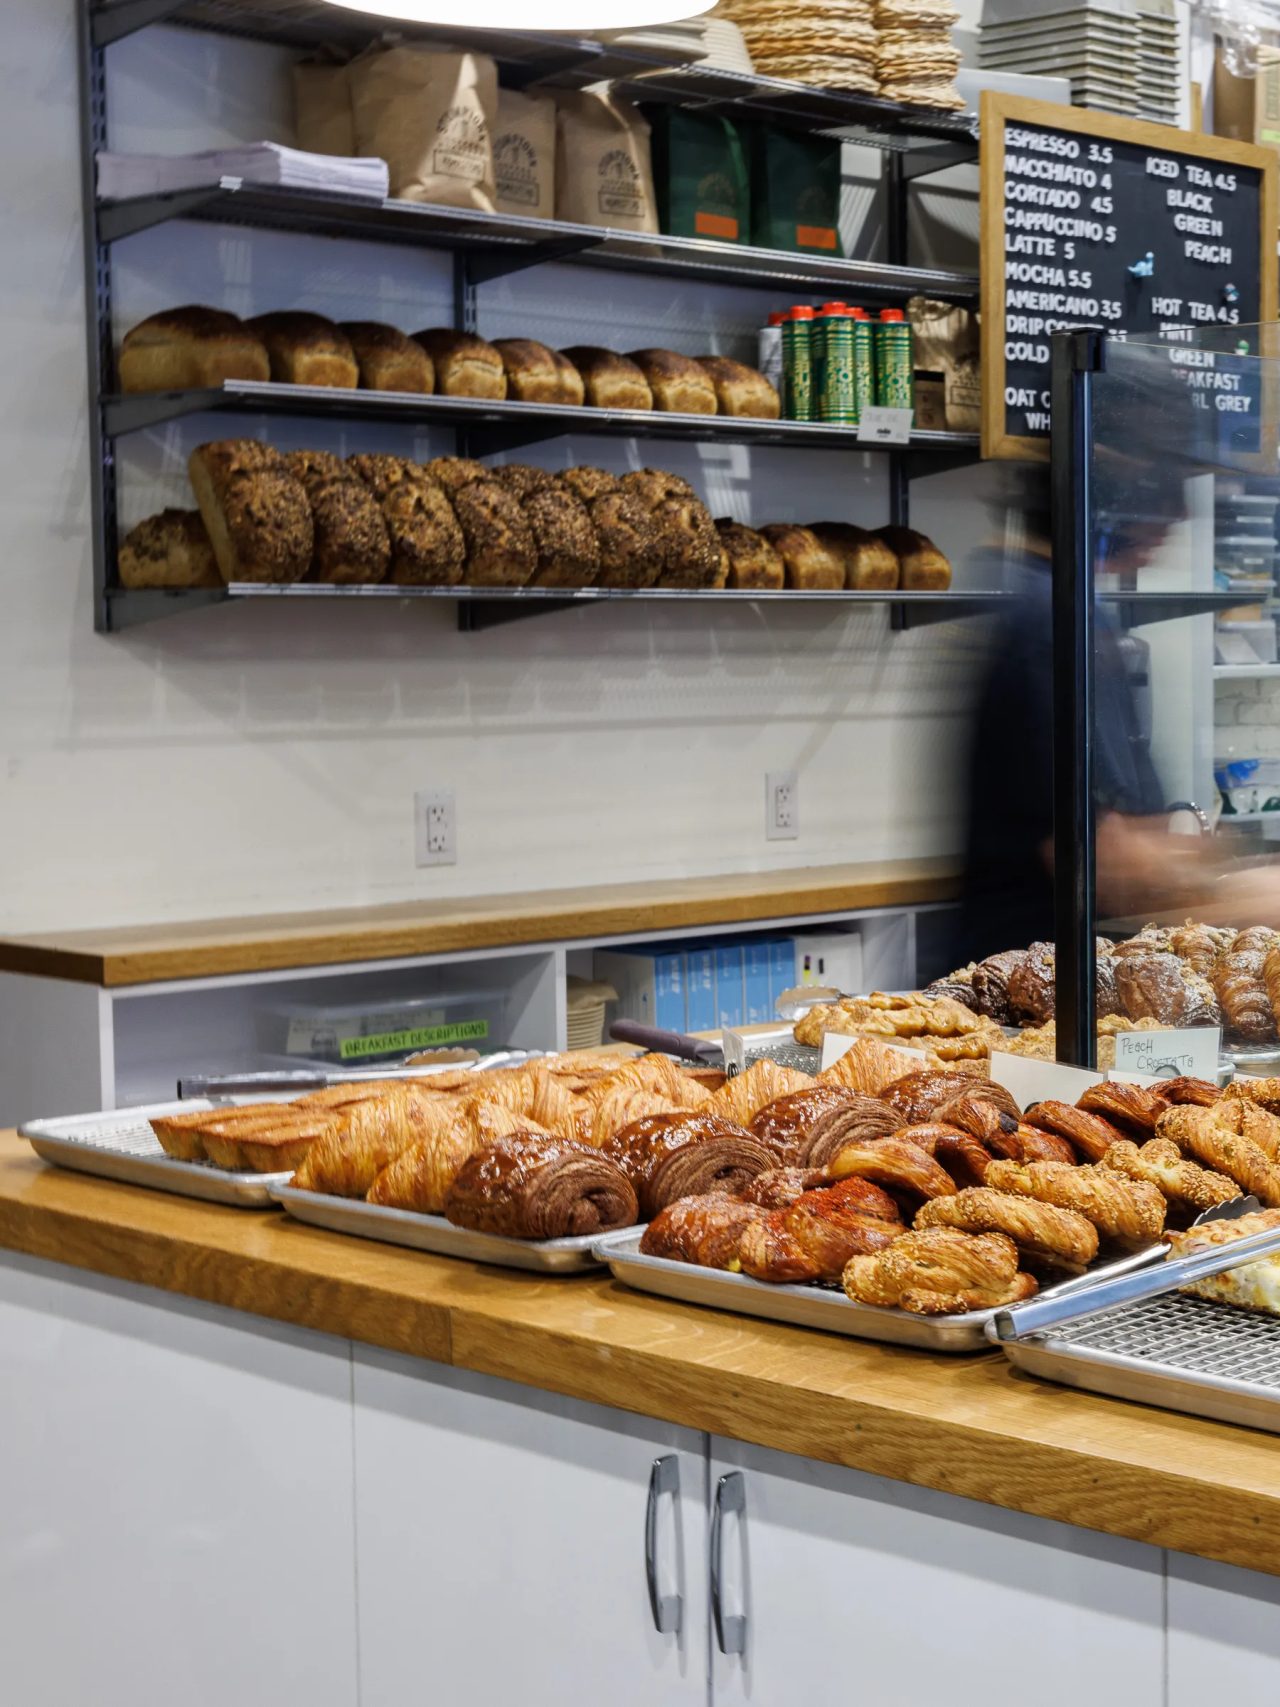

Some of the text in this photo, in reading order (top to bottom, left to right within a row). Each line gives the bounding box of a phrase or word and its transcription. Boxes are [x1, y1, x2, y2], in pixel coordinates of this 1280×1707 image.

[1004, 127, 1113, 164] ESPRESSO 3.5
[1004, 154, 1113, 190] MACCHIATO 4
[1146, 156, 1237, 192] ICED TEA 4.5
[1004, 181, 1081, 210] CORTADO
[1166, 188, 1214, 214] BLACK
[1004, 207, 1118, 243] CAPPUCCINO 5
[1174, 213, 1224, 237] GREEN
[1005, 234, 1076, 260] LATTE 5
[1184, 240, 1233, 265] PEACH
[1005, 261, 1093, 289] MOCHA 5.5
[1005, 289, 1100, 317] AMERICANO
[1151, 296, 1240, 325] HOT TEA 4.5
[1006, 315, 1044, 336] DRIP
[1159, 322, 1197, 343] MINT
[1004, 341, 1050, 364] COLD
[1168, 348, 1216, 368] GREEN
[1004, 386, 1038, 407] OAT
[1214, 394, 1252, 413] GREY
[343, 1032, 408, 1056] BREAKFAST
[410, 1021, 487, 1047] DESCRIPTIONS
